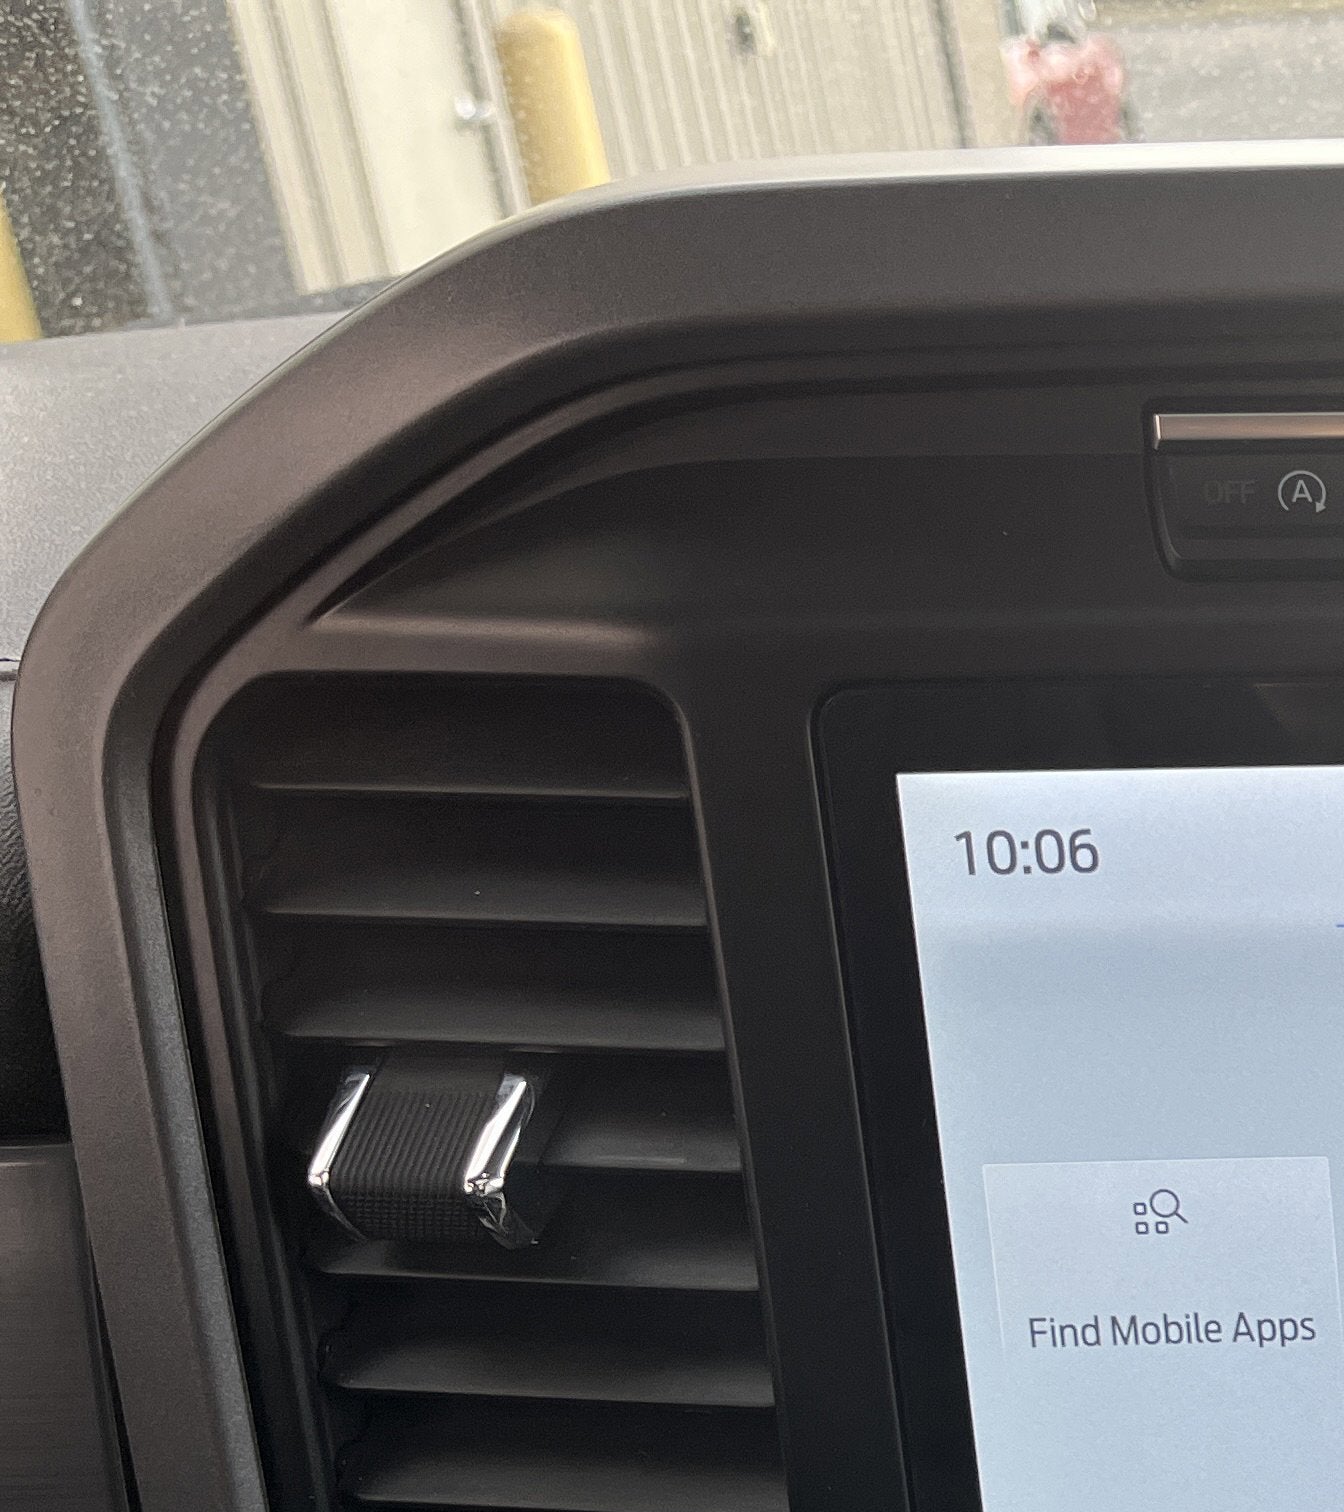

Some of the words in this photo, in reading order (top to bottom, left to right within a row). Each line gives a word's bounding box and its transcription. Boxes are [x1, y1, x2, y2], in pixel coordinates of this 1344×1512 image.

[954, 828, 1099, 876] 10:06
[1028, 1314, 1102, 1348] Find
[1110, 1312, 1222, 1346] Mobile
[1232, 1311, 1316, 1348] Apps
